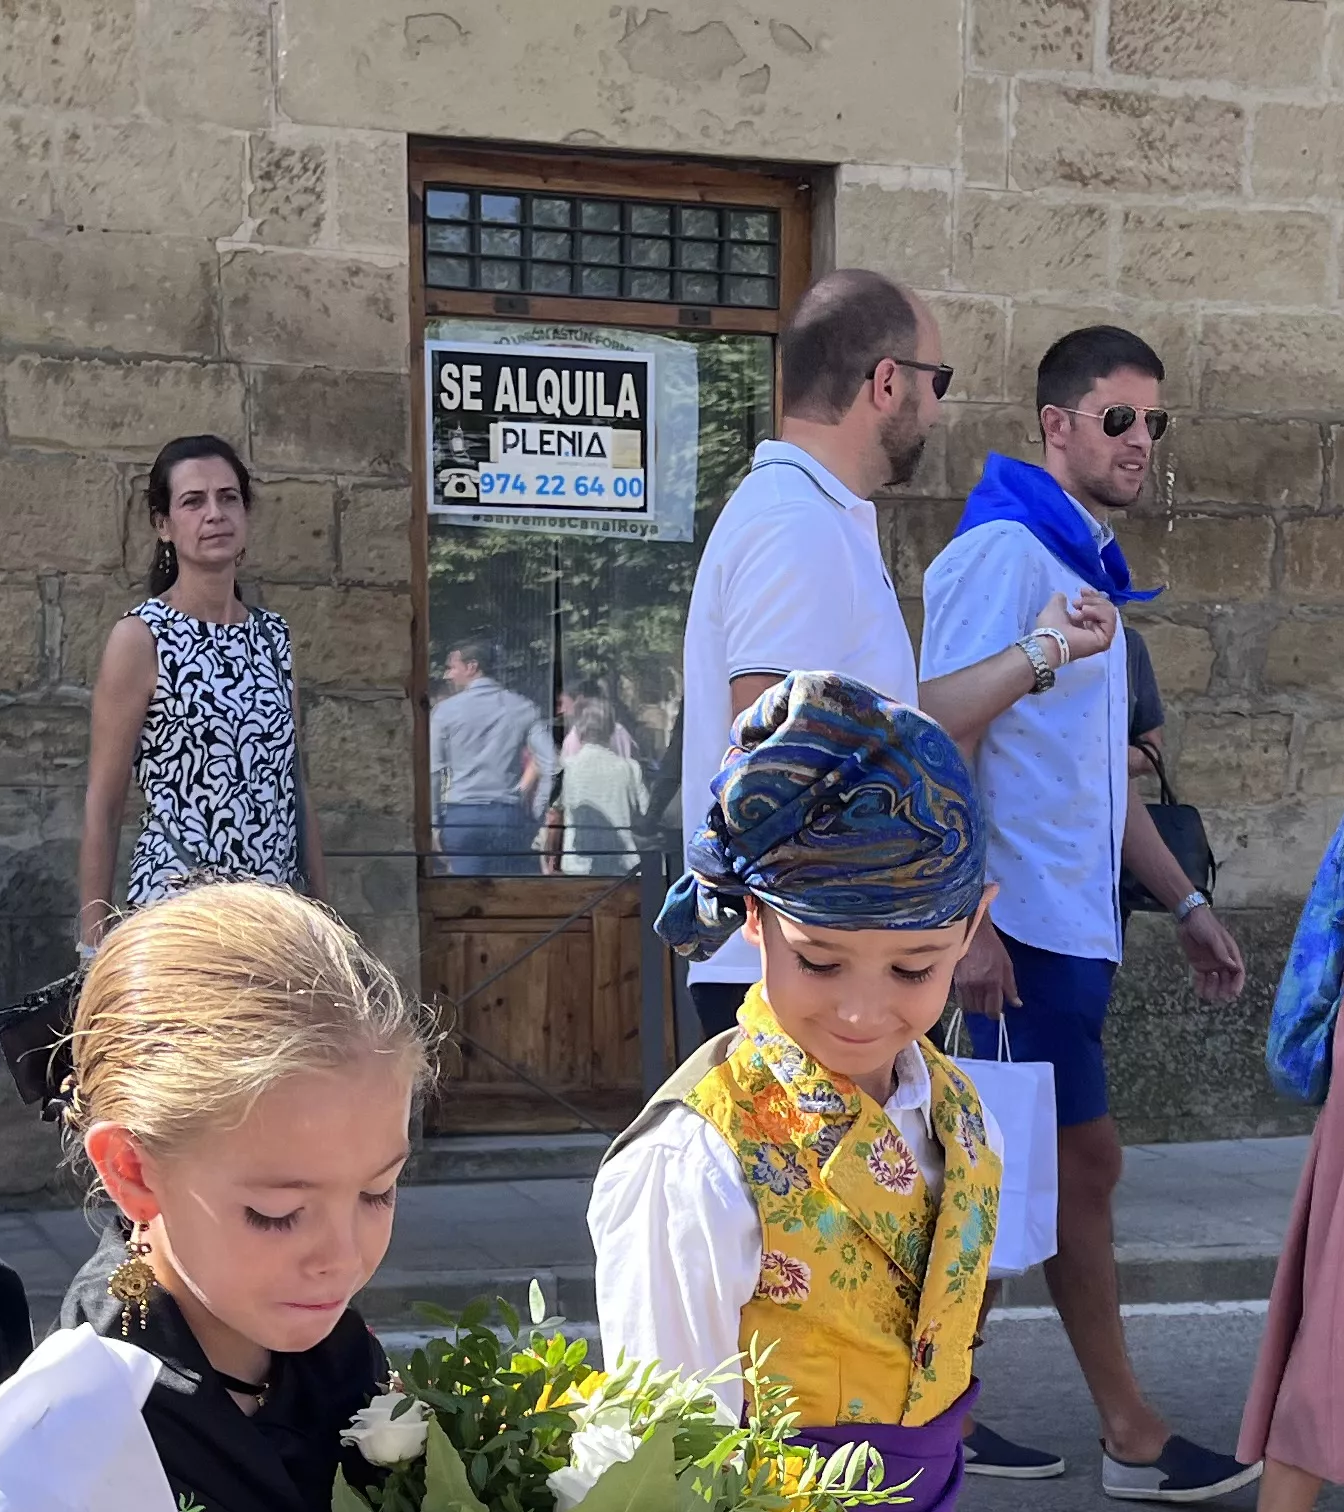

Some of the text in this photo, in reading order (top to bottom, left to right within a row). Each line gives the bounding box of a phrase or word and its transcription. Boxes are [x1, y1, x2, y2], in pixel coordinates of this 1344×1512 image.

[439, 362, 640, 419] SE ALQUILA
[501, 427, 608, 459] PLENIA
[479, 473, 643, 498] 974 22 64 00
